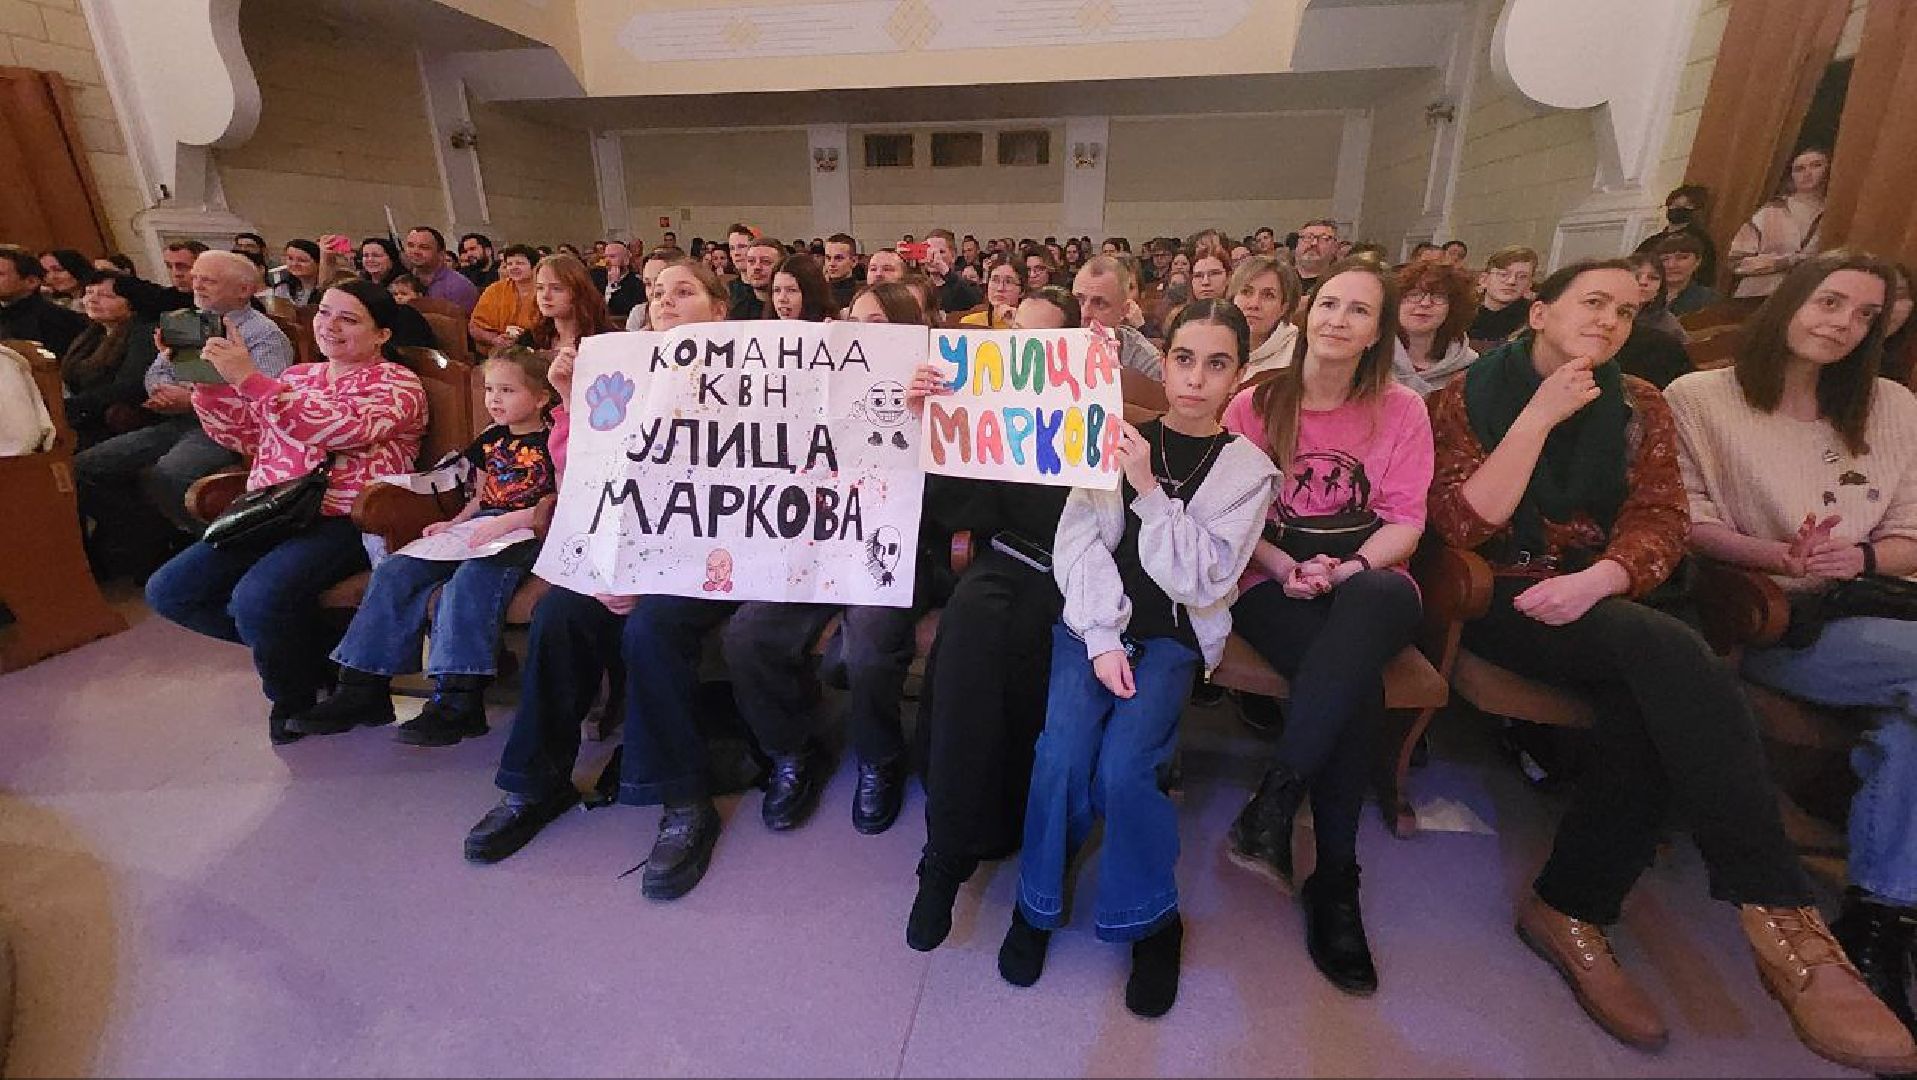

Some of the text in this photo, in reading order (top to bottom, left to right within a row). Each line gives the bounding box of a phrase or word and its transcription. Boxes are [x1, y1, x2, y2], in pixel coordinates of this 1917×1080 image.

[649, 337, 870, 372] КОМАНДА
[938, 335, 1114, 401] УЛИЦА
[699, 373, 787, 408] КВН
[626, 417, 838, 474] УЛИЦА
[930, 402, 1120, 475] МАРКОВА
[588, 478, 863, 541] МАРКОВА
